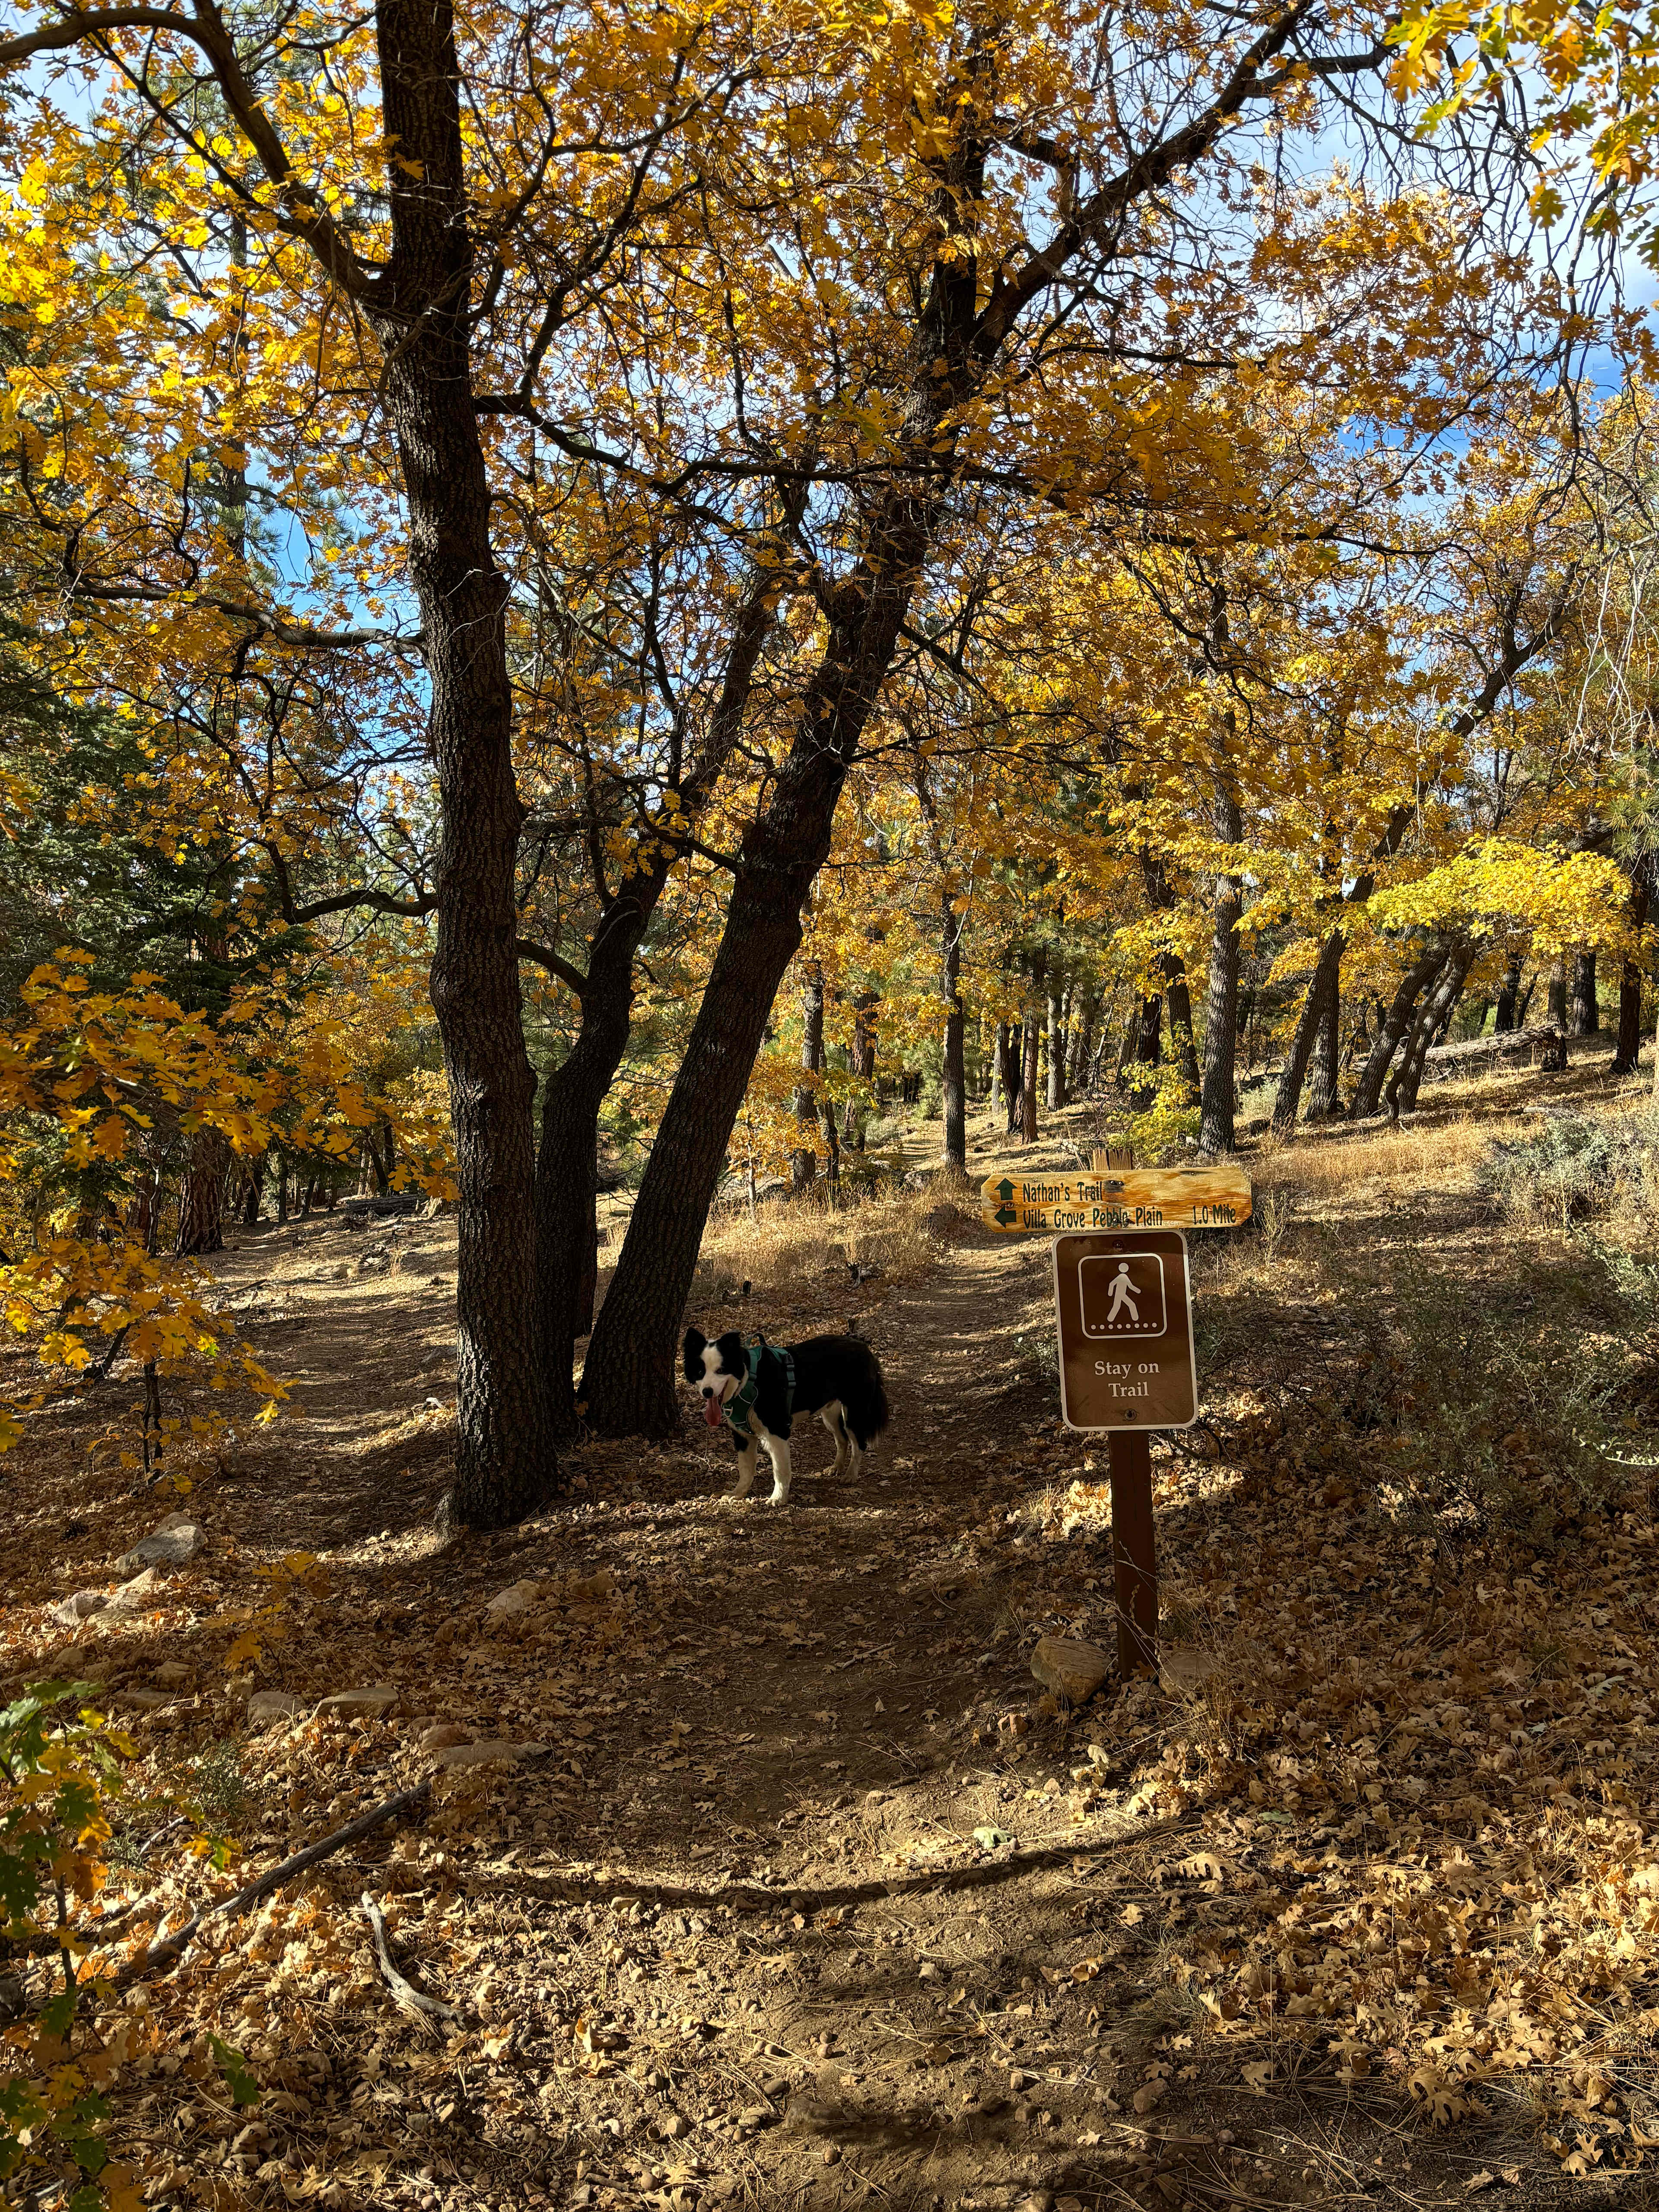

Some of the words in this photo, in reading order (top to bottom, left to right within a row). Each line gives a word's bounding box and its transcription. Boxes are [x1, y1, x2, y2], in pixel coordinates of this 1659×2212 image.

[1023, 1182, 1070, 1202] Nathan's
[1077, 1181, 1103, 1201] Trail
[1023, 1209, 1046, 1229] Villa
[1054, 1209, 1085, 1228] Grove
[1093, 1207, 1128, 1227] Pebble
[1136, 1206, 1163, 1226] Plain
[1193, 1205, 1208, 1225] 1.0
[1213, 1203, 1236, 1224] Mile
[1094, 1361, 1131, 1379] Stay
[1138, 1362, 1160, 1374] on
[1108, 1382, 1150, 1398] Trail
